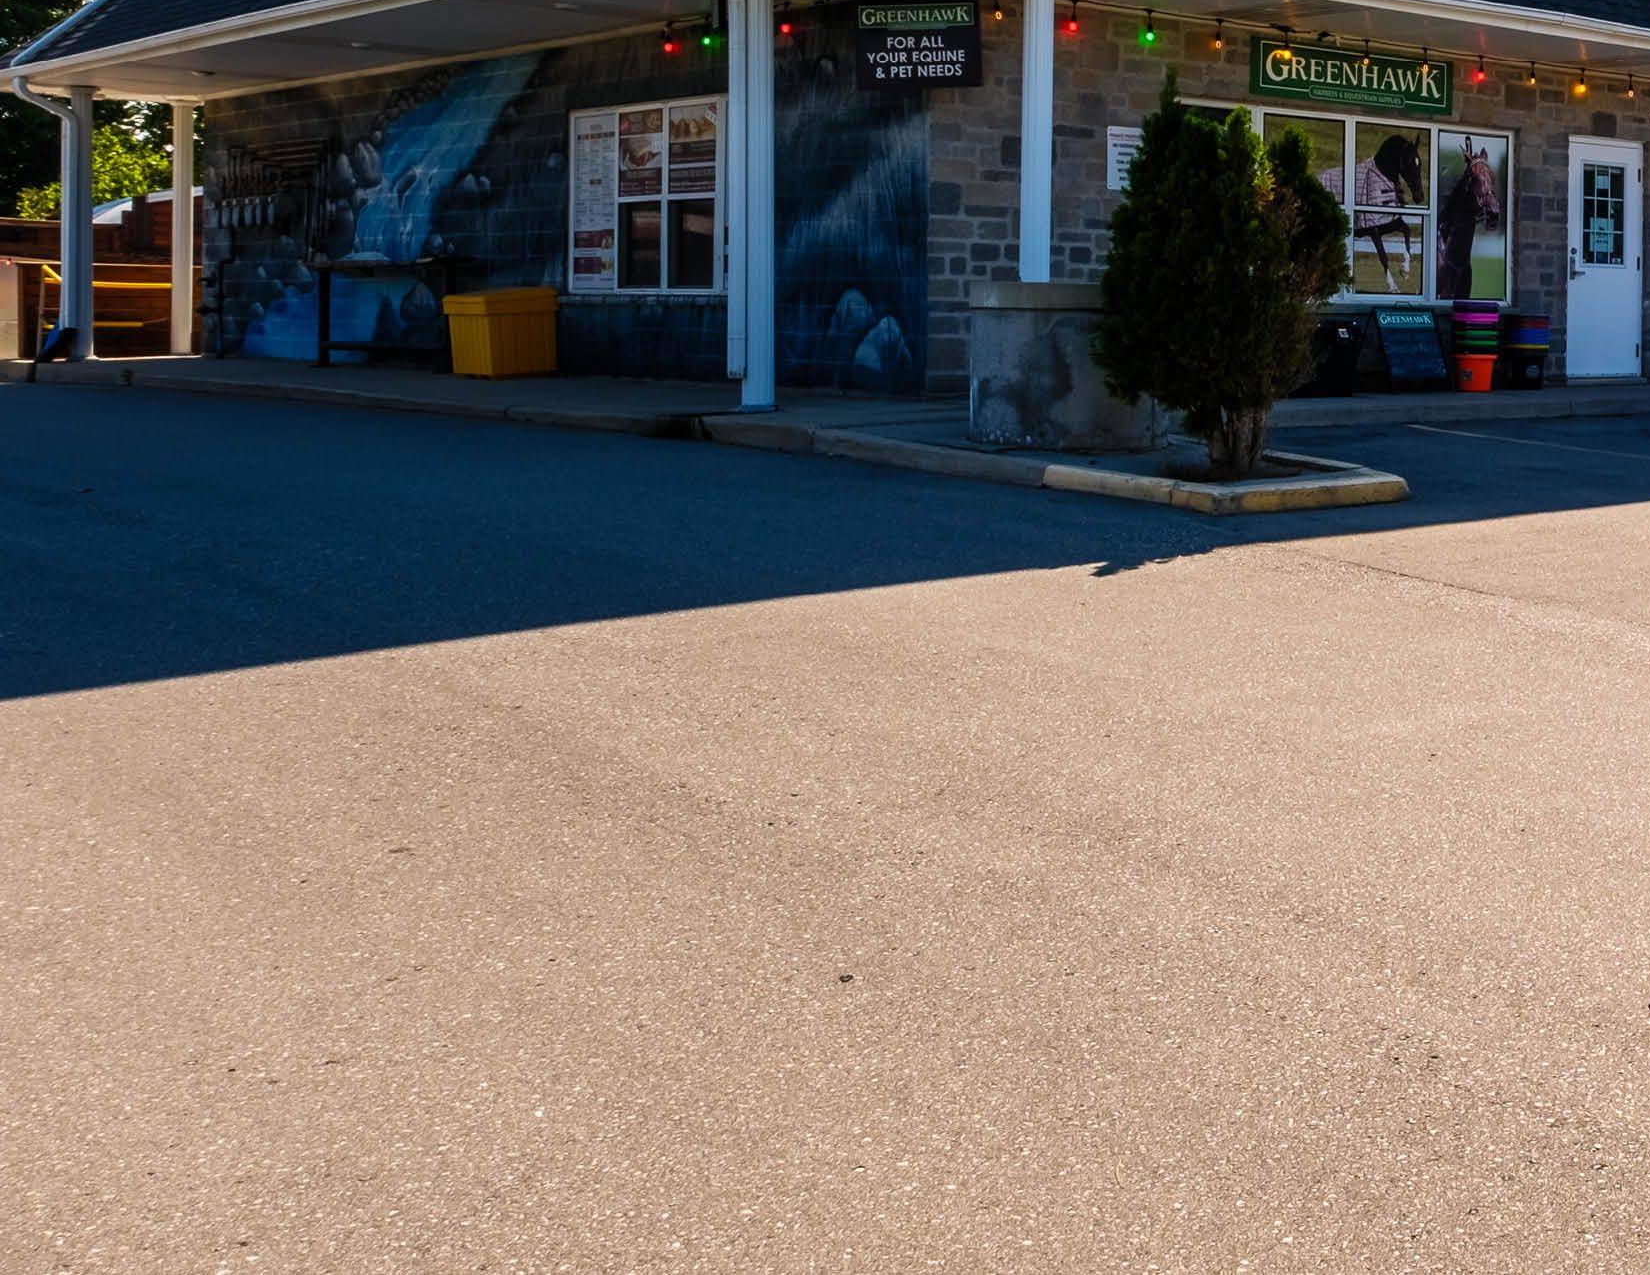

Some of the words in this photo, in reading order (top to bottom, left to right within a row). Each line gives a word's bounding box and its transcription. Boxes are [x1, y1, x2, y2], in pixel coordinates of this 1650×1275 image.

[862, 6, 969, 25] GREENHAWK
[886, 36, 916, 50] FOR
[919, 35, 945, 48] ALL
[866, 52, 908, 65] YOUR
[911, 49, 966, 63] EQUINE
[875, 67, 886, 79] &
[890, 65, 913, 78] PET
[917, 63, 963, 78] NEEDS
[1265, 48, 1441, 99] GREENHAWK
[1380, 314, 1432, 325] GREENHAWK
